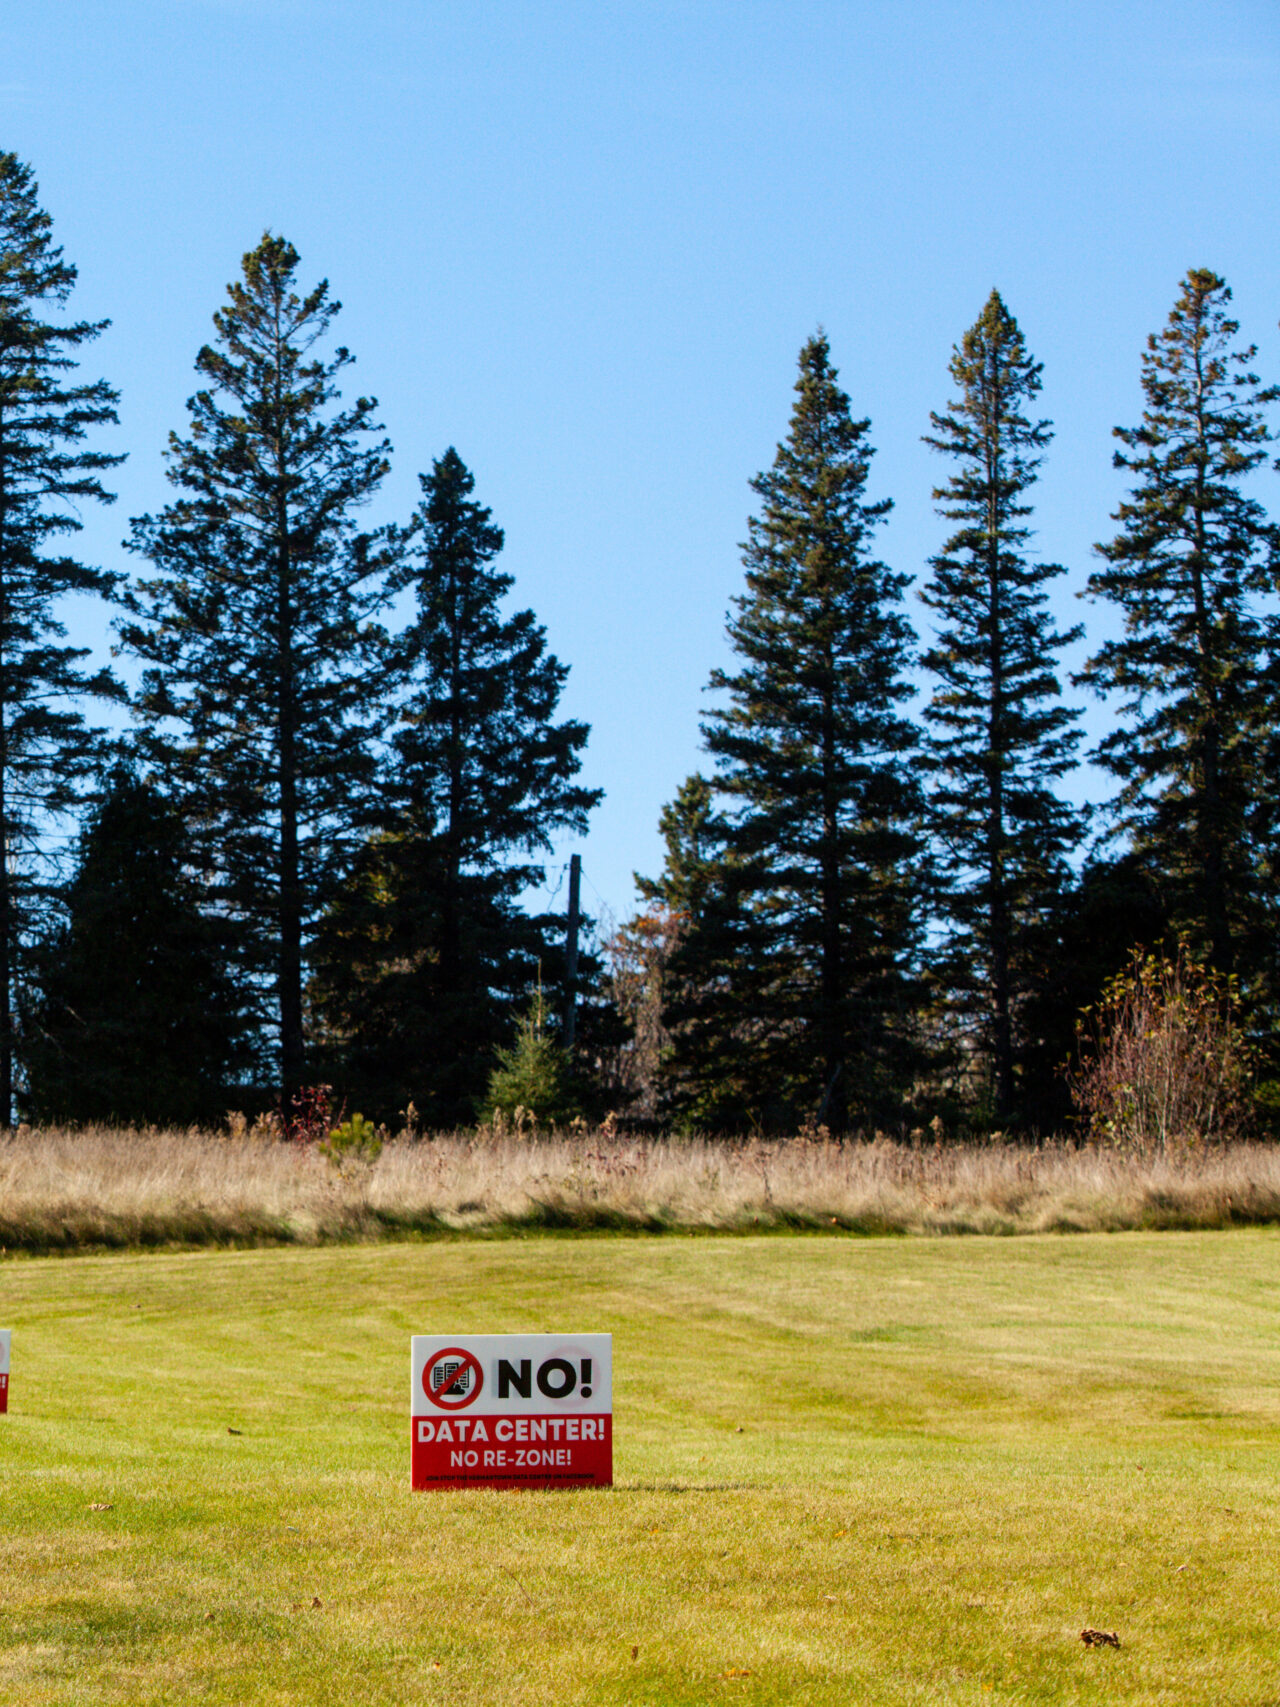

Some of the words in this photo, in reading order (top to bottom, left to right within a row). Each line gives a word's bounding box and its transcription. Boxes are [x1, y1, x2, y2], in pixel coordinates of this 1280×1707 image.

[498, 1358, 592, 1399] NO!
[417, 1419, 490, 1443] DATA
[494, 1418, 605, 1441] CENTER!
[450, 1450, 479, 1467] NO
[483, 1449, 572, 1466] RE-ZONE!
